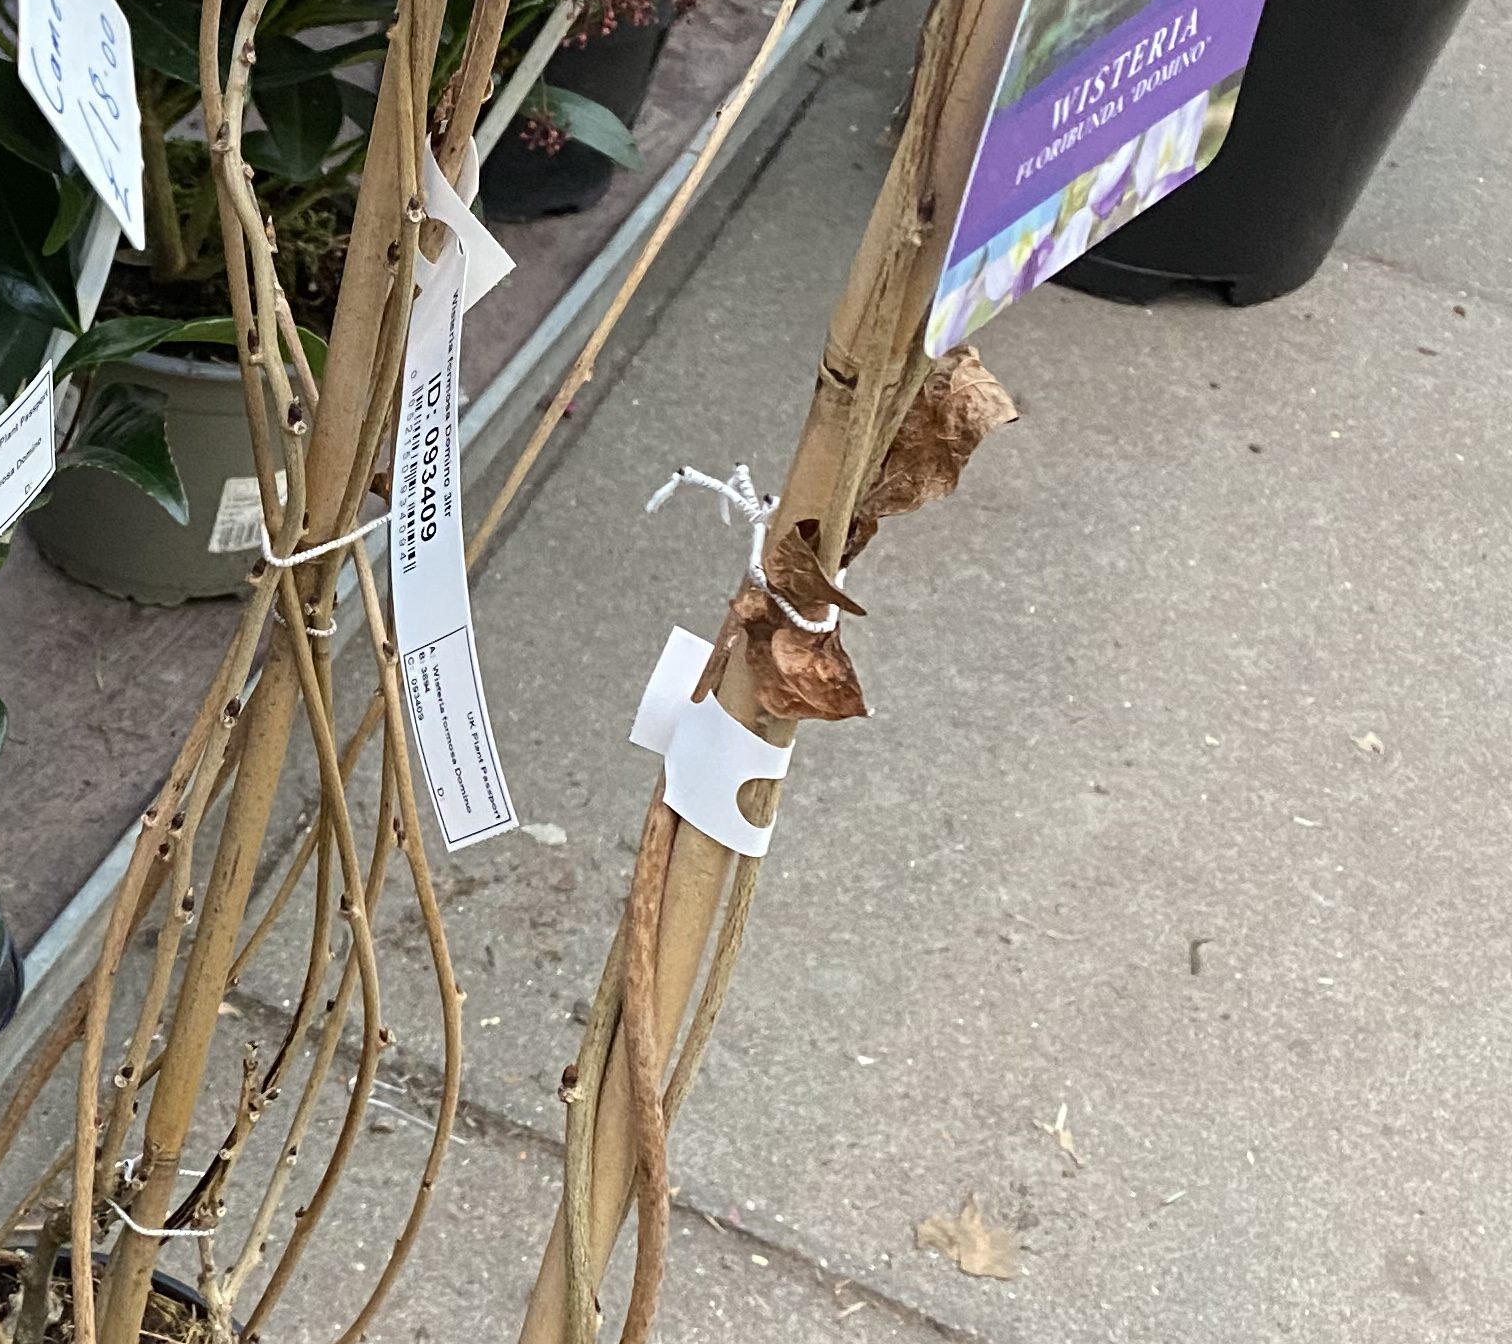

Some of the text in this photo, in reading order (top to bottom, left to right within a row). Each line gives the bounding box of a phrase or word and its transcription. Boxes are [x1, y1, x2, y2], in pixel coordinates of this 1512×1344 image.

[1051, 7, 1198, 132] WISTERIA
[419, 371, 442, 542] ID: 093409
